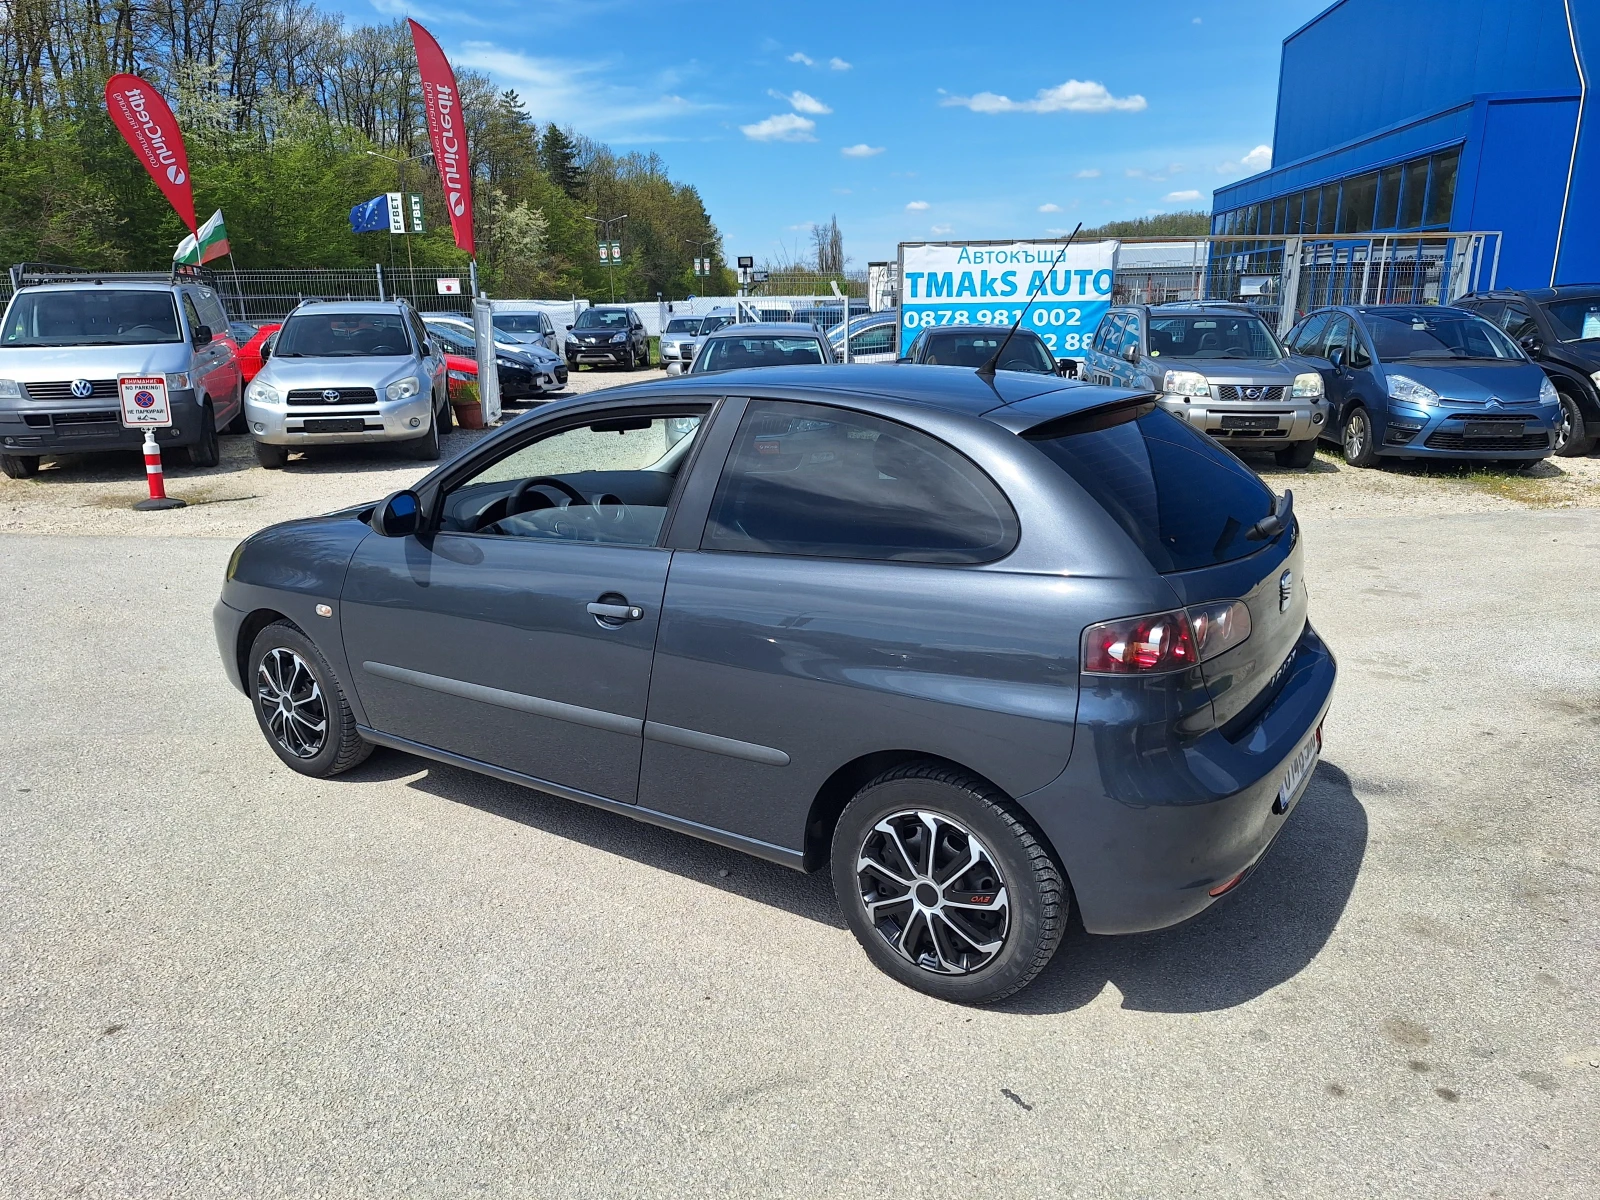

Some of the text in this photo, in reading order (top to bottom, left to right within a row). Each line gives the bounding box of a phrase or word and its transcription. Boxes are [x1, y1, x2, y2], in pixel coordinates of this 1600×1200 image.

[391, 196, 402, 231] EFBET
[411, 195, 423, 231] EFBET
[957, 246, 1066, 266] Автокъща
[905, 268, 1113, 298] TMAkS AUTO
[904, 310, 969, 328] 0878
[1032, 308, 1082, 327] 002
